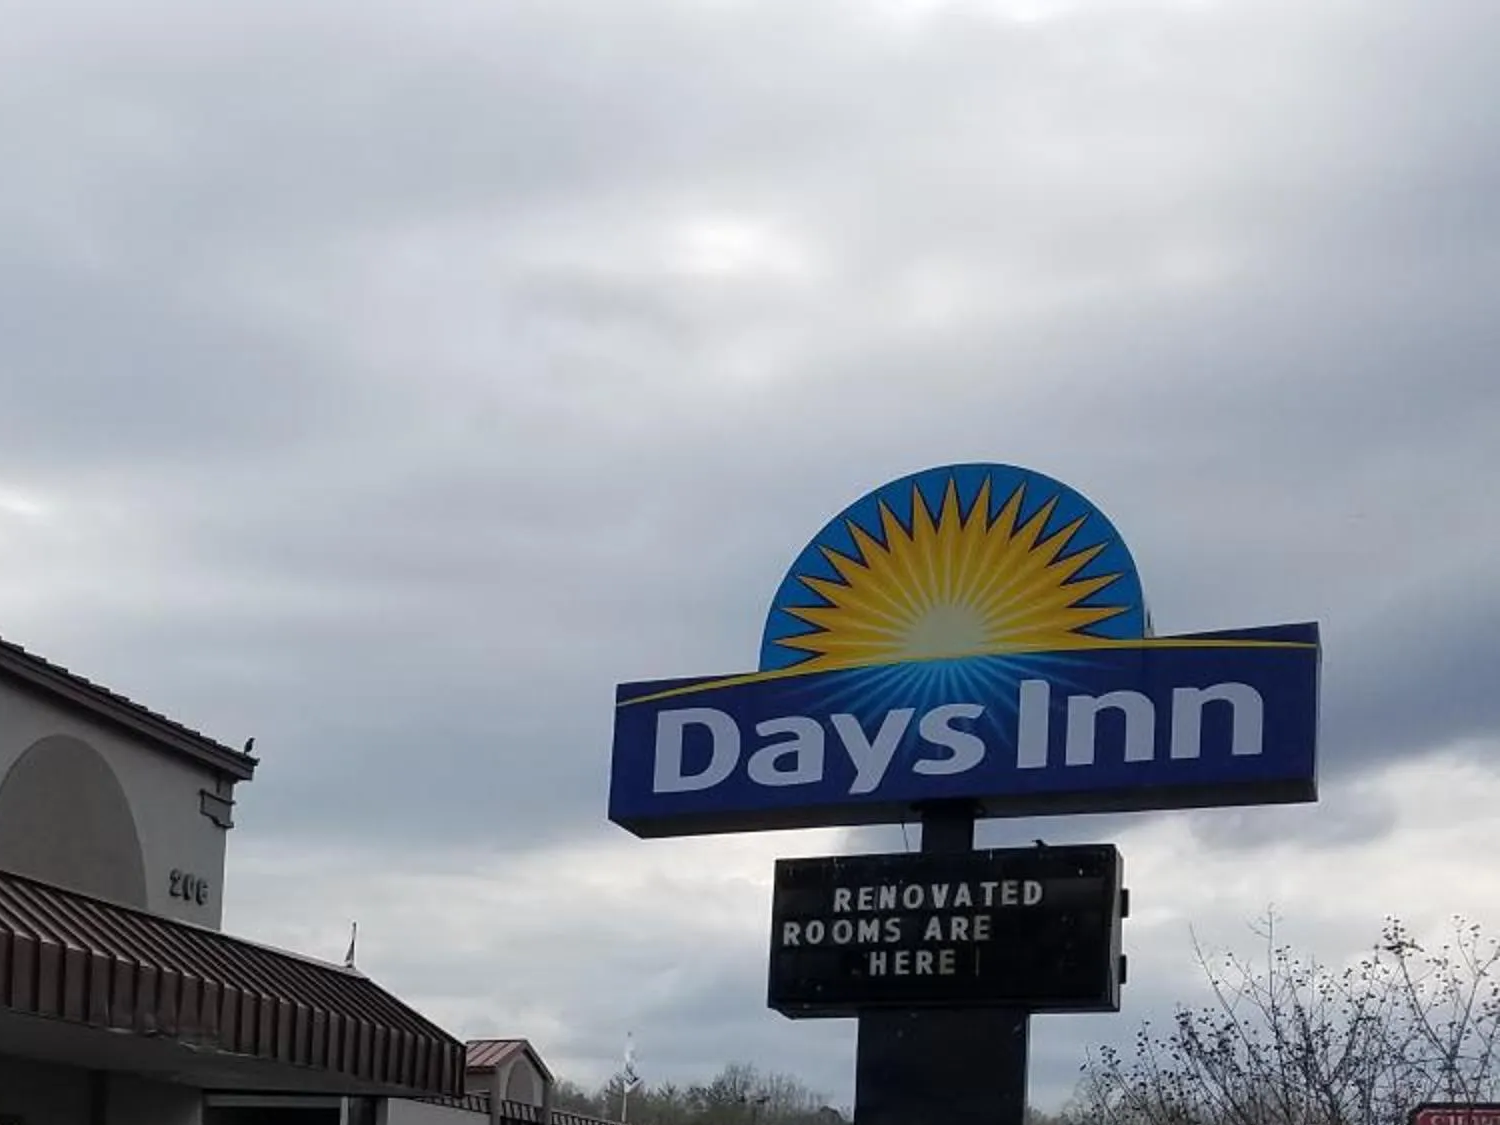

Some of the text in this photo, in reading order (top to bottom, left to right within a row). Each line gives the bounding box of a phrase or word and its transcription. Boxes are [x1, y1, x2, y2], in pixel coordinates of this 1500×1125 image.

[652, 679, 1264, 795] Days Inn
[833, 880, 1043, 912] RENOVATED
[782, 914, 991, 946] ROOMS ARE
[869, 949, 956, 976] HERE
